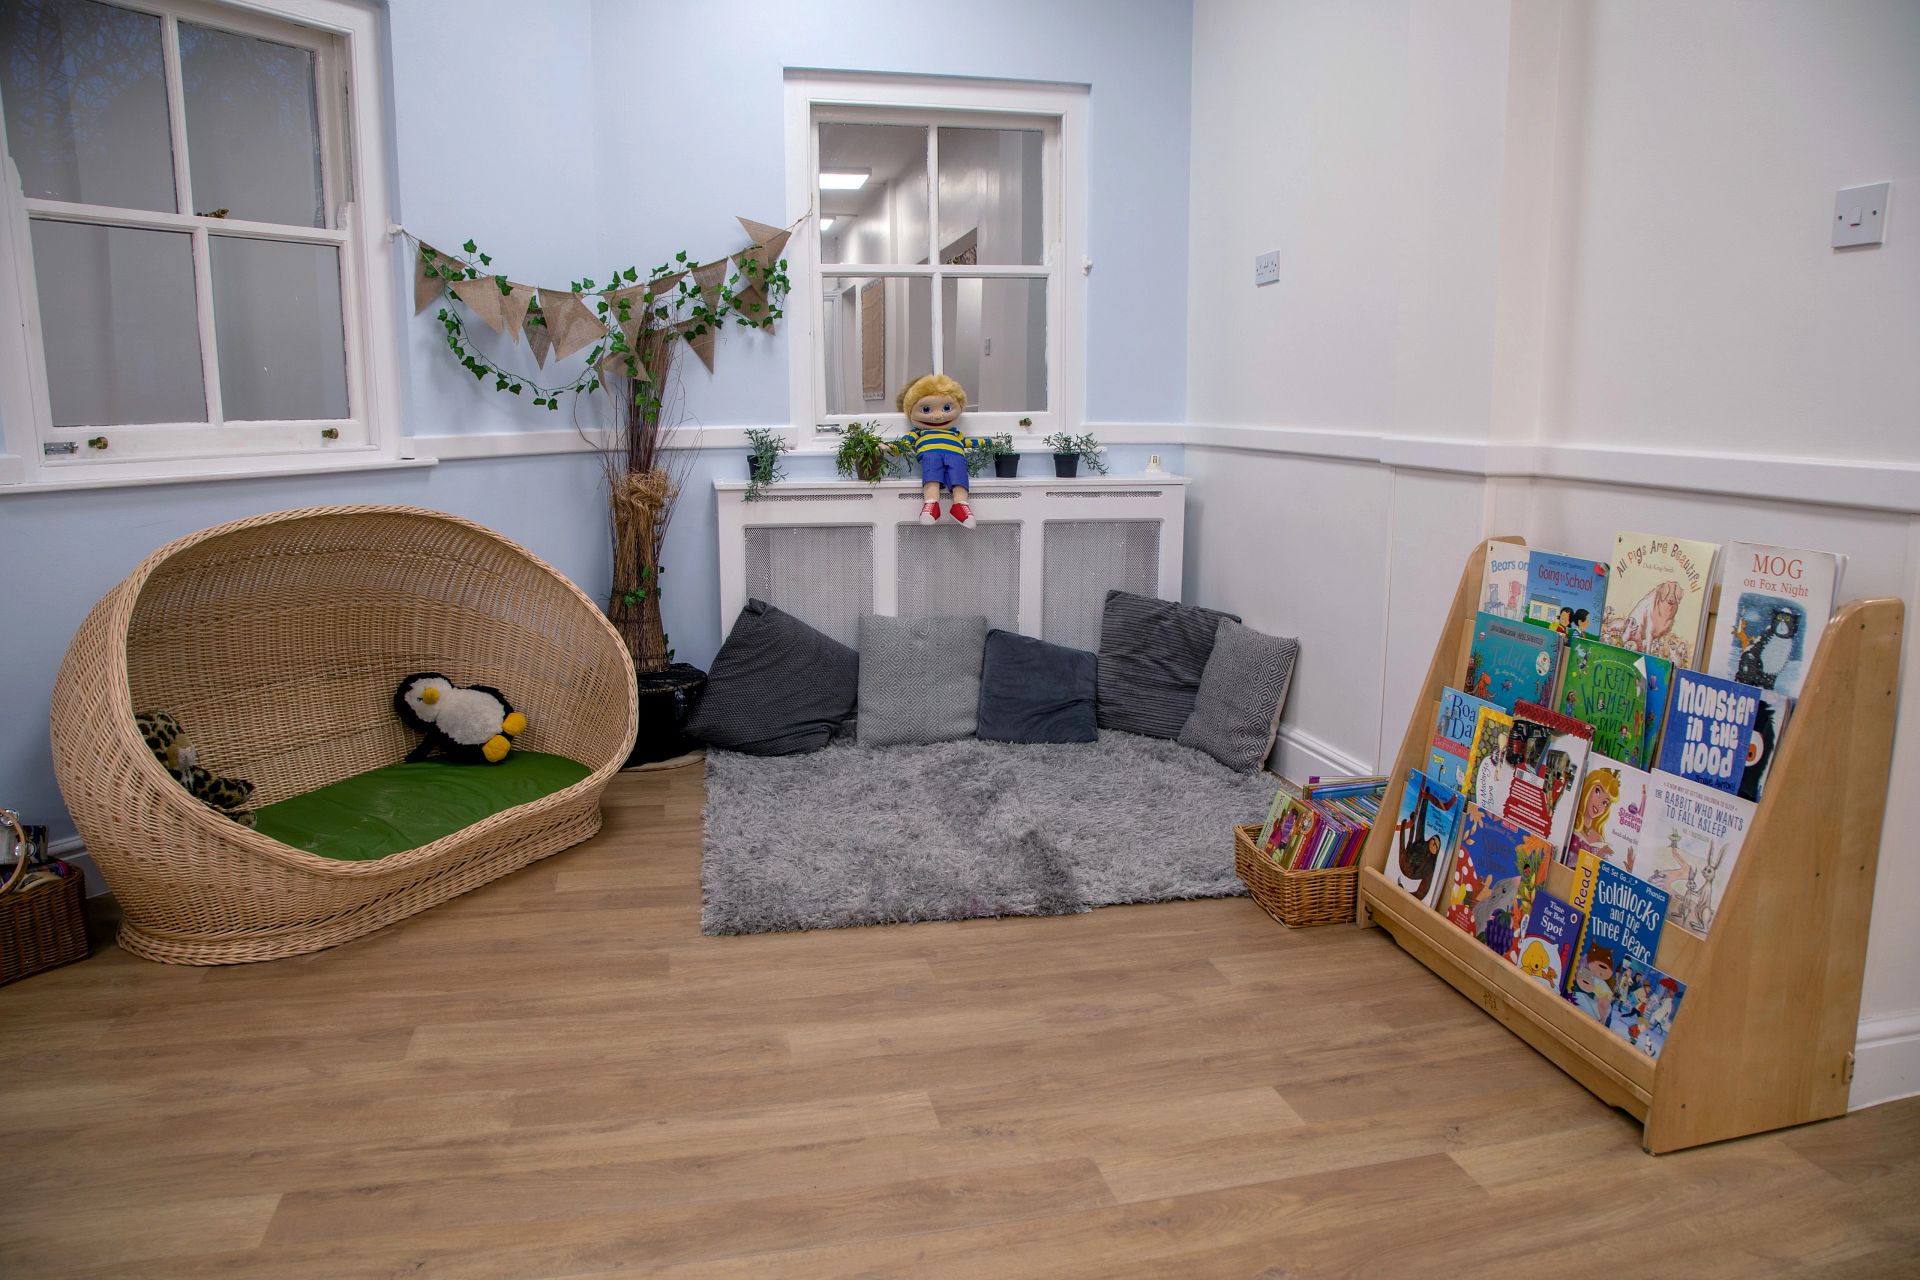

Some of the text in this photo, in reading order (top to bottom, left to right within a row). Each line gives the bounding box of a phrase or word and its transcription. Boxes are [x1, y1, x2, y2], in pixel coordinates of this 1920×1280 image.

[1491, 559, 1516, 573] Bears
[1538, 564, 1560, 586] Going
[1565, 572, 1594, 592] School
[1616, 540, 1702, 593] All Pigs Are Beautiful
[1752, 553, 1804, 579] MOG
[1743, 578, 1809, 598] on Fox Night
[1594, 663, 1634, 696] GREAT
[1450, 694, 1476, 722] Roa
[1581, 683, 1636, 722] WOMEN
[1450, 717, 1476, 740] Da
[1686, 715, 1704, 742] in
[1664, 790, 1692, 812] RABBIT
[1694, 801, 1713, 819] WHO
[1715, 809, 1744, 831] WANTS
[1666, 804, 1676, 819] TO
[1677, 809, 1695, 827] FALL
[1697, 816, 1727, 838] ASLEEP
[1601, 863, 1627, 882] Get Set Go
[1573, 866, 1592, 909] Read
[1645, 886, 1666, 902] Phonics
[1544, 906, 1566, 925] for Bed,
[1550, 900, 1565, 914] Time
[1598, 880, 1660, 931] Goldilocks
[1540, 915, 1563, 937] Spot
[1609, 907, 1640, 934] and the
[1591, 916, 1651, 964] Three Bears
